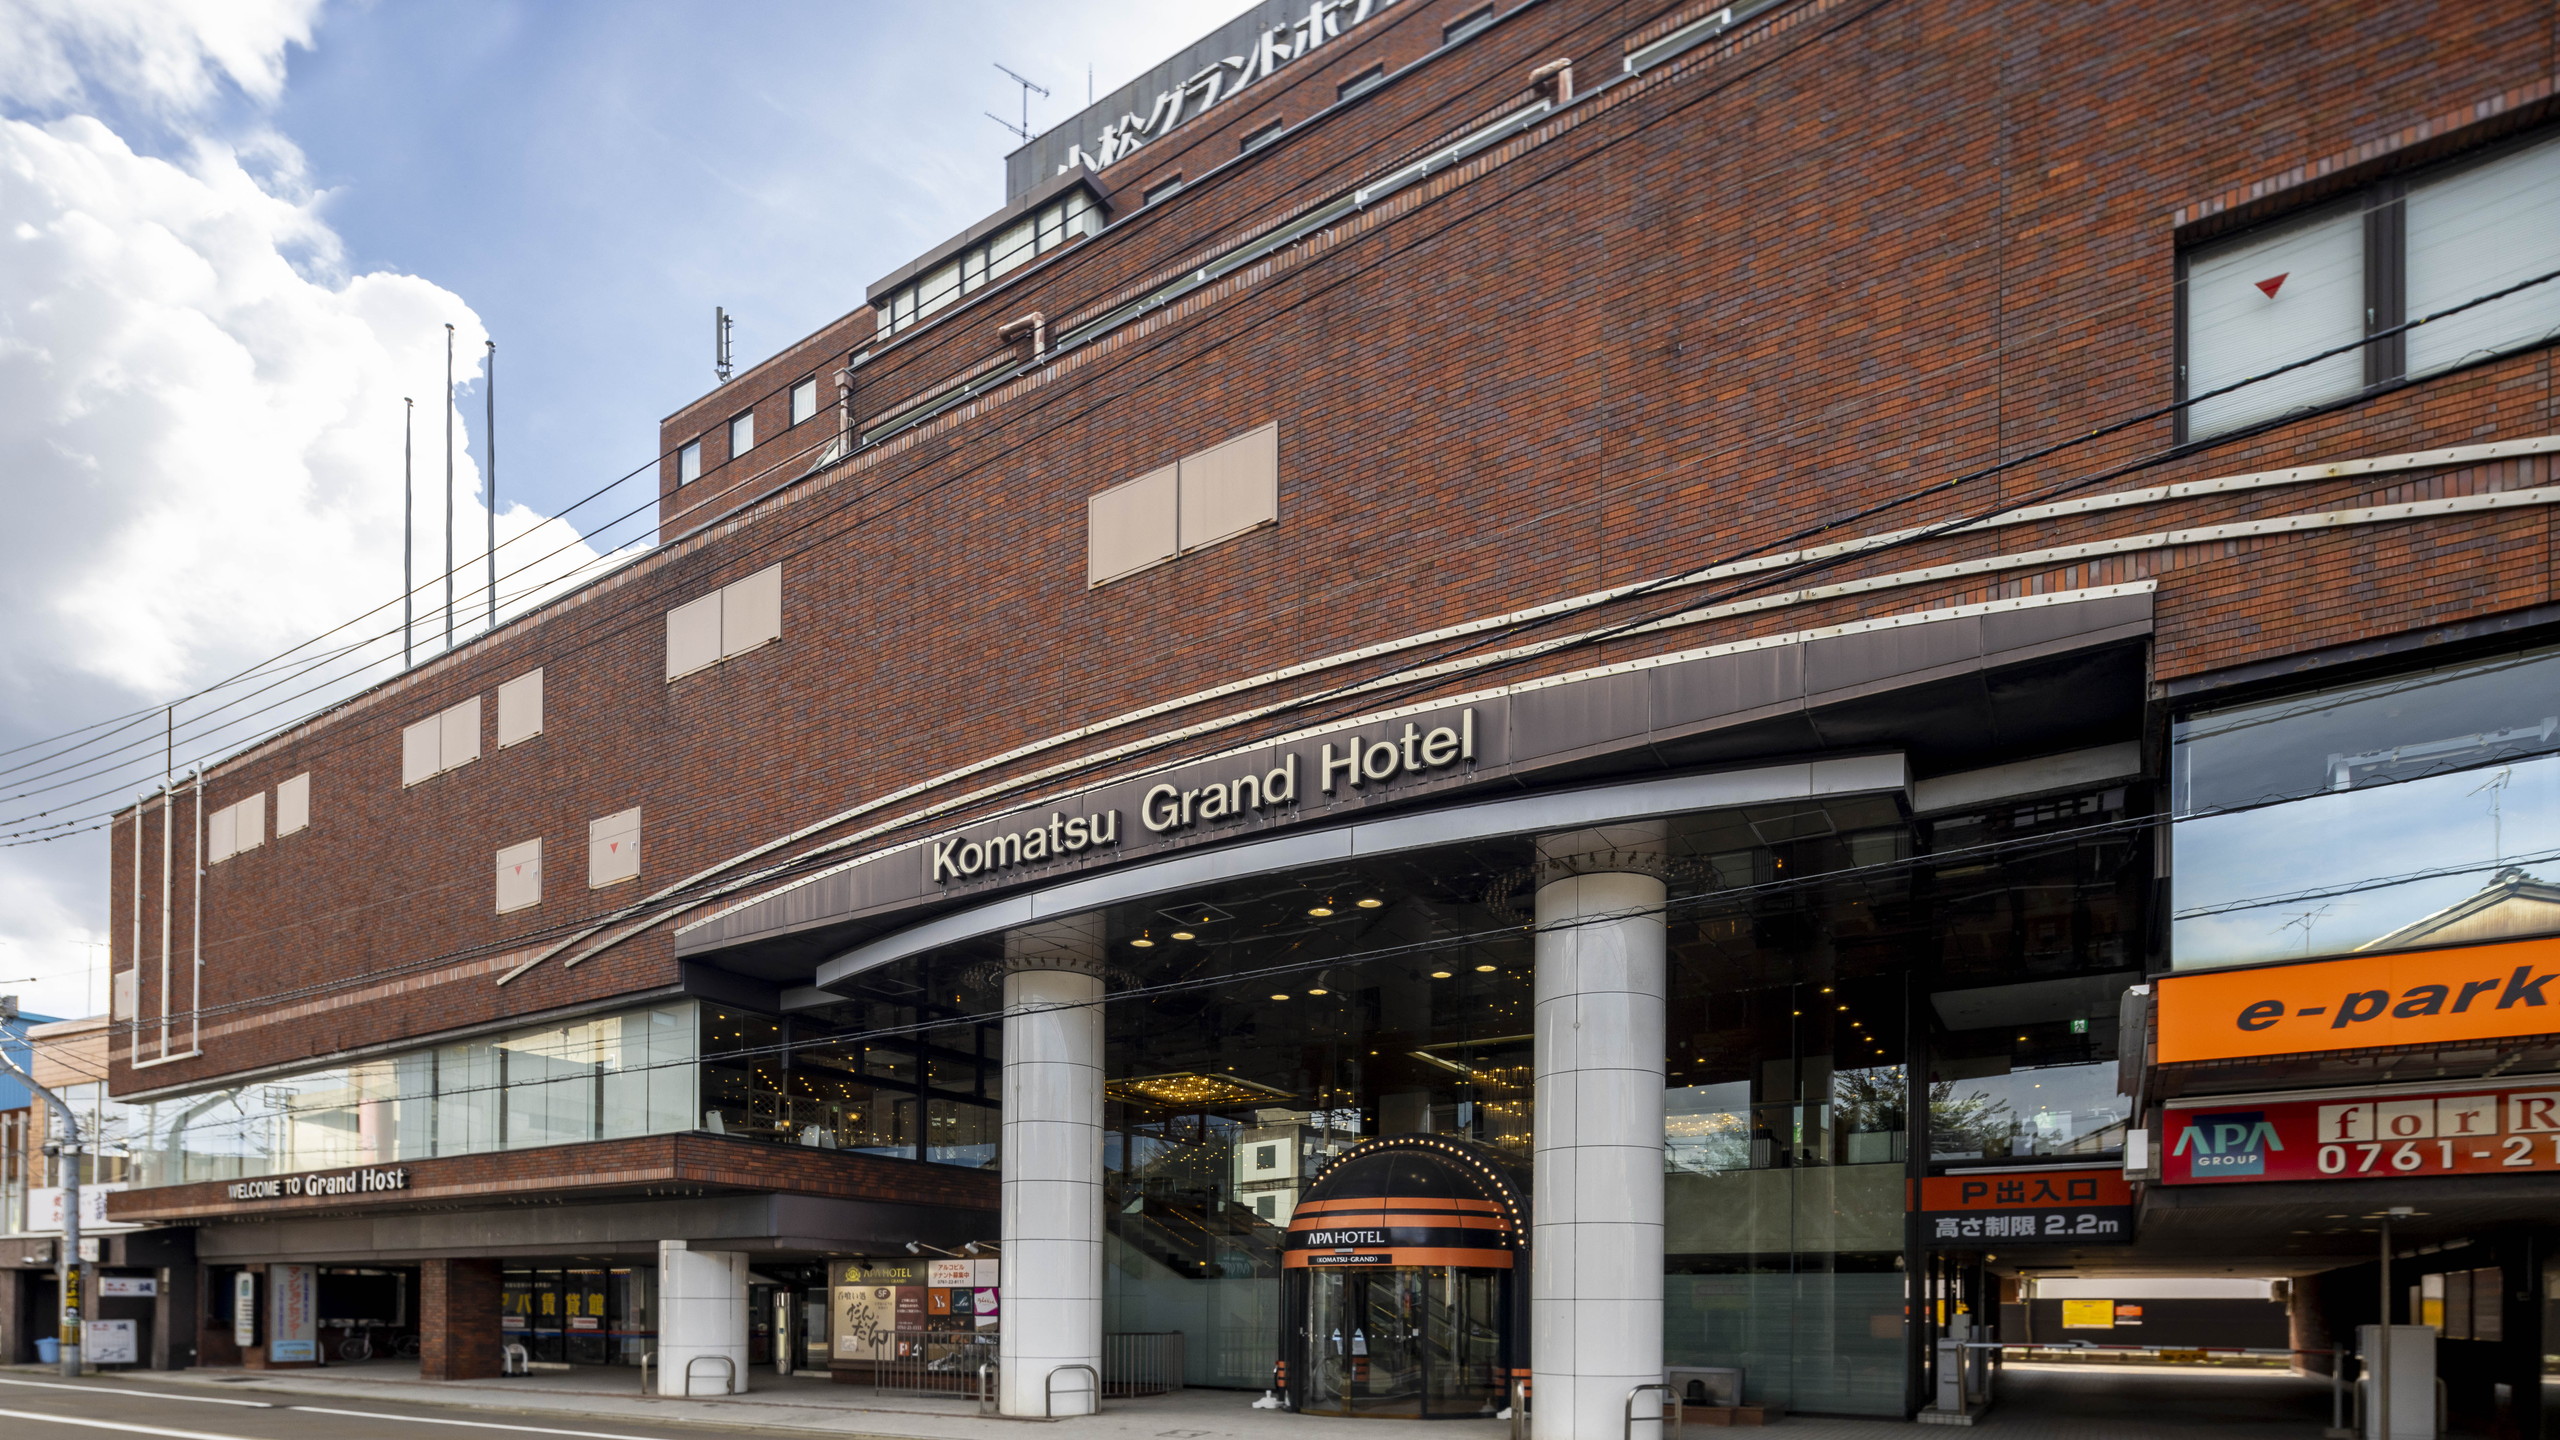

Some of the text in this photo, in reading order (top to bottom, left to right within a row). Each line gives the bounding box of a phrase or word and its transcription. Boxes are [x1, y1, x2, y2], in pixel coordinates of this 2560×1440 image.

[1057, 0, 1395, 175] 小松グランドホ
[932, 707, 1475, 883] Komatsu Grand Hotel
[2172, 1121, 2285, 1156] APA
[2198, 1154, 2258, 1167] GROUP
[228, 1168, 405, 1199] WELCOME TO Grand Host
[1307, 1230, 1385, 1244] APA HOTEL
[1935, 1214, 2119, 1238] 高さ制限 2.2m
[882, 1267, 912, 1278] HOTEL
